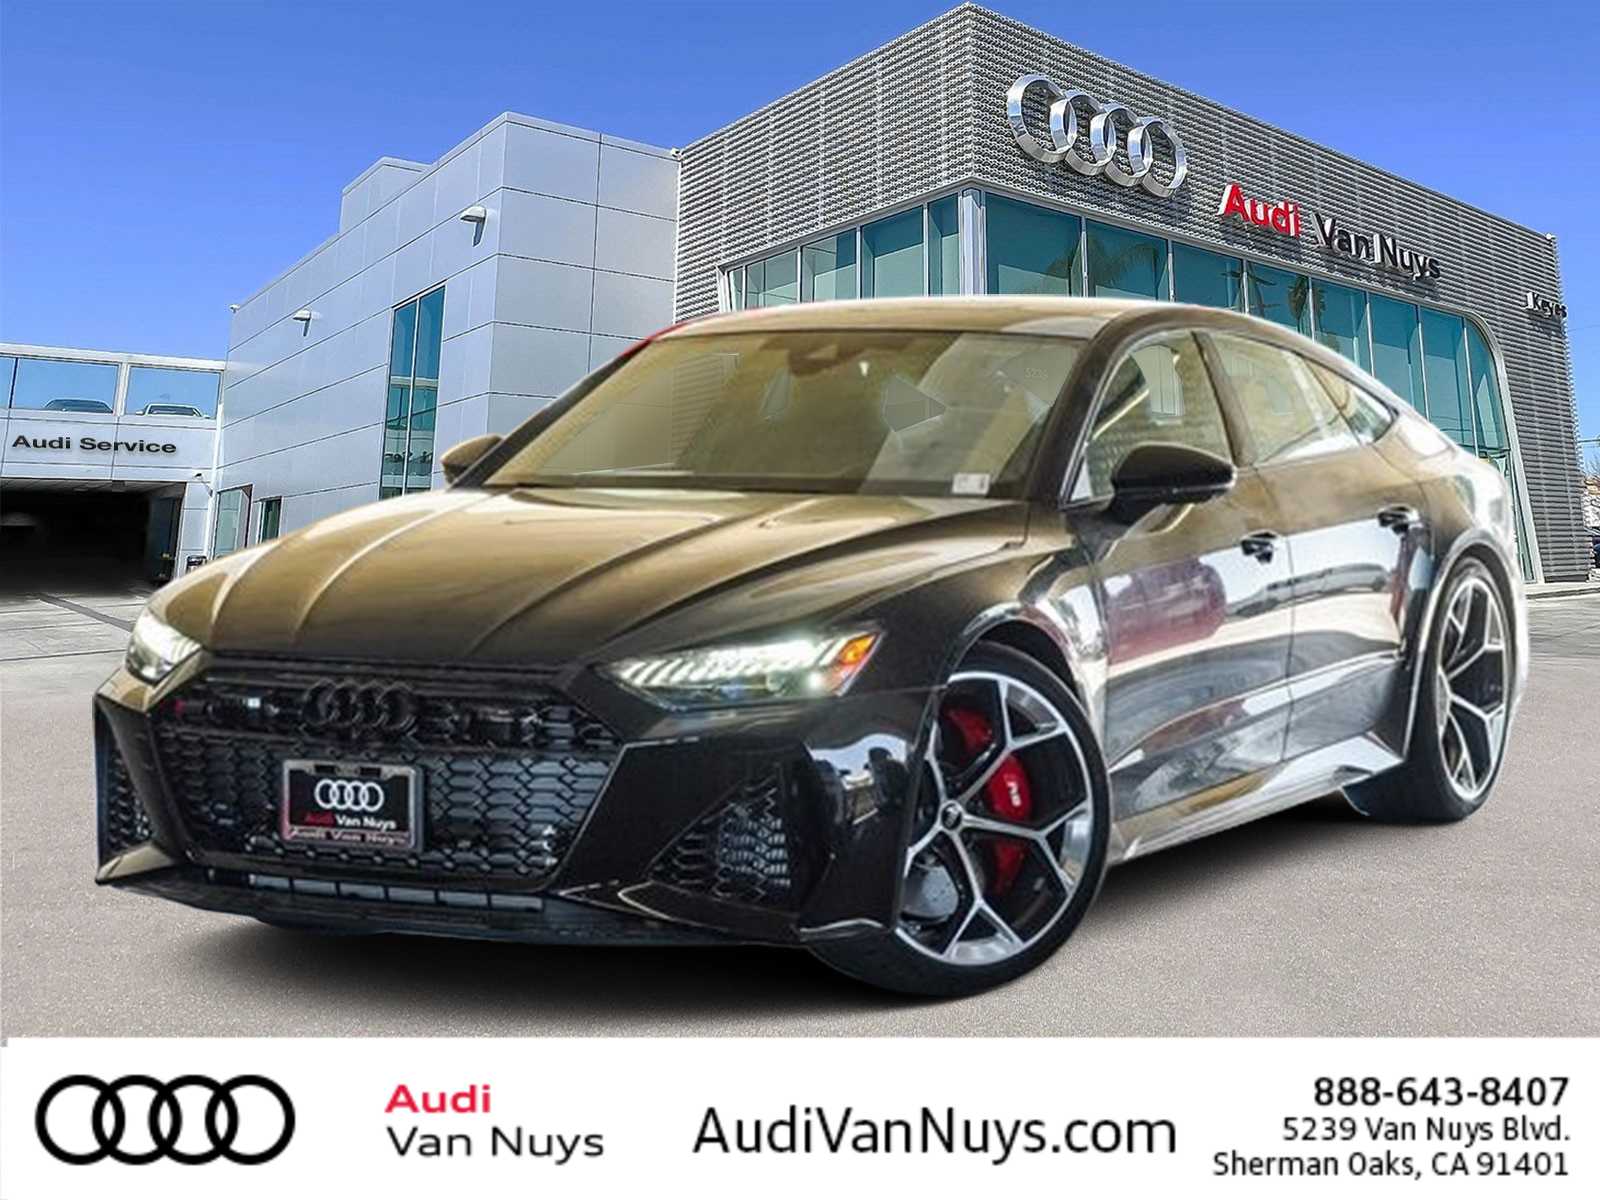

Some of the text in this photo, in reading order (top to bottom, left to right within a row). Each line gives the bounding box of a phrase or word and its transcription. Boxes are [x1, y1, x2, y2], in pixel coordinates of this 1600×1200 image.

[1217, 182, 1441, 280] Audi Van Nuys
[12, 435, 177, 454] Audi Service
[335, 814, 361, 826] Van
[362, 816, 397, 832] Nuys
